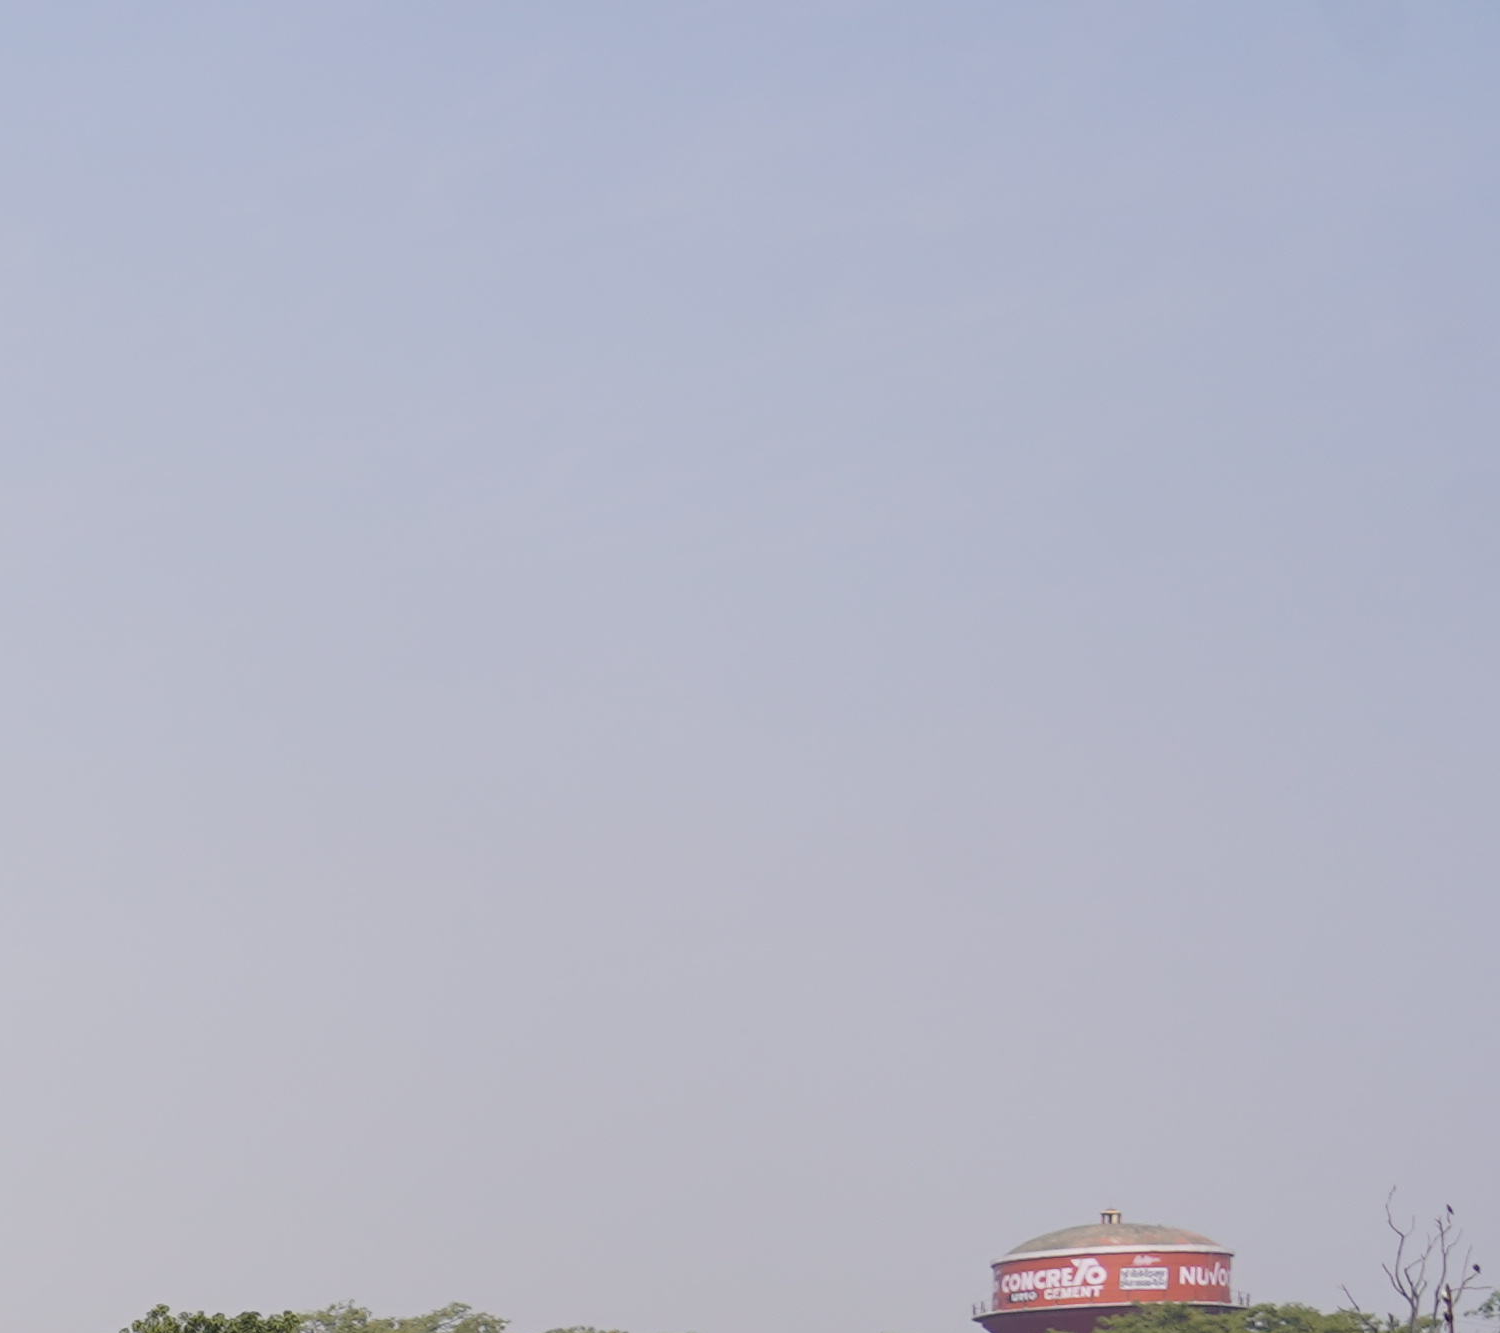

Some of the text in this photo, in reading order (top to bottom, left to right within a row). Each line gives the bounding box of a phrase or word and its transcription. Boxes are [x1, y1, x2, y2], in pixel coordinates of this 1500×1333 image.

[1001, 1258, 1107, 1293] CONCRETO
[1179, 1261, 1229, 1286] NUVO
[1043, 1284, 1104, 1300] CEMENT
